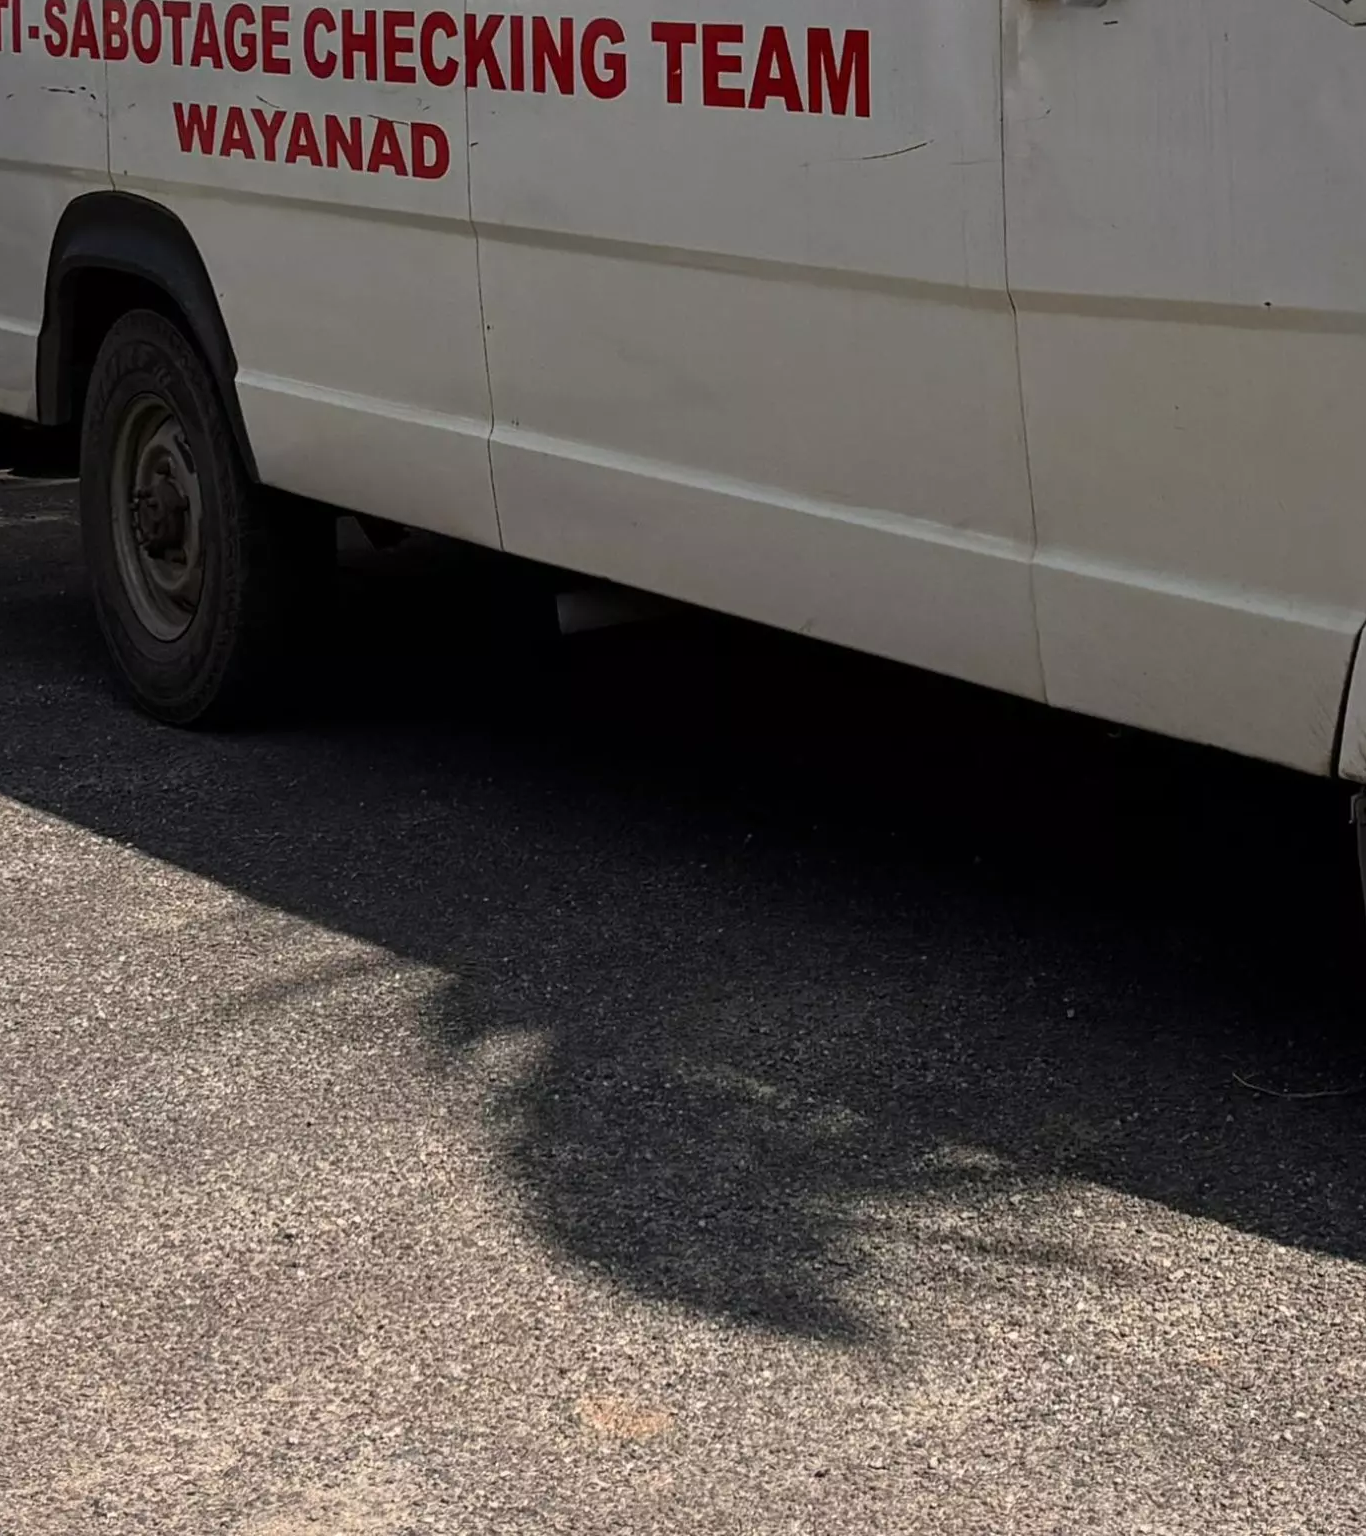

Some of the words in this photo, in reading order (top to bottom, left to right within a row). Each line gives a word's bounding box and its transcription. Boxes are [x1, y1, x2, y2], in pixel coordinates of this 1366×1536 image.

[303, 7, 629, 101] CHECKING
[650, 21, 872, 118] TEAM
[173, 102, 451, 181] WAYANAD
